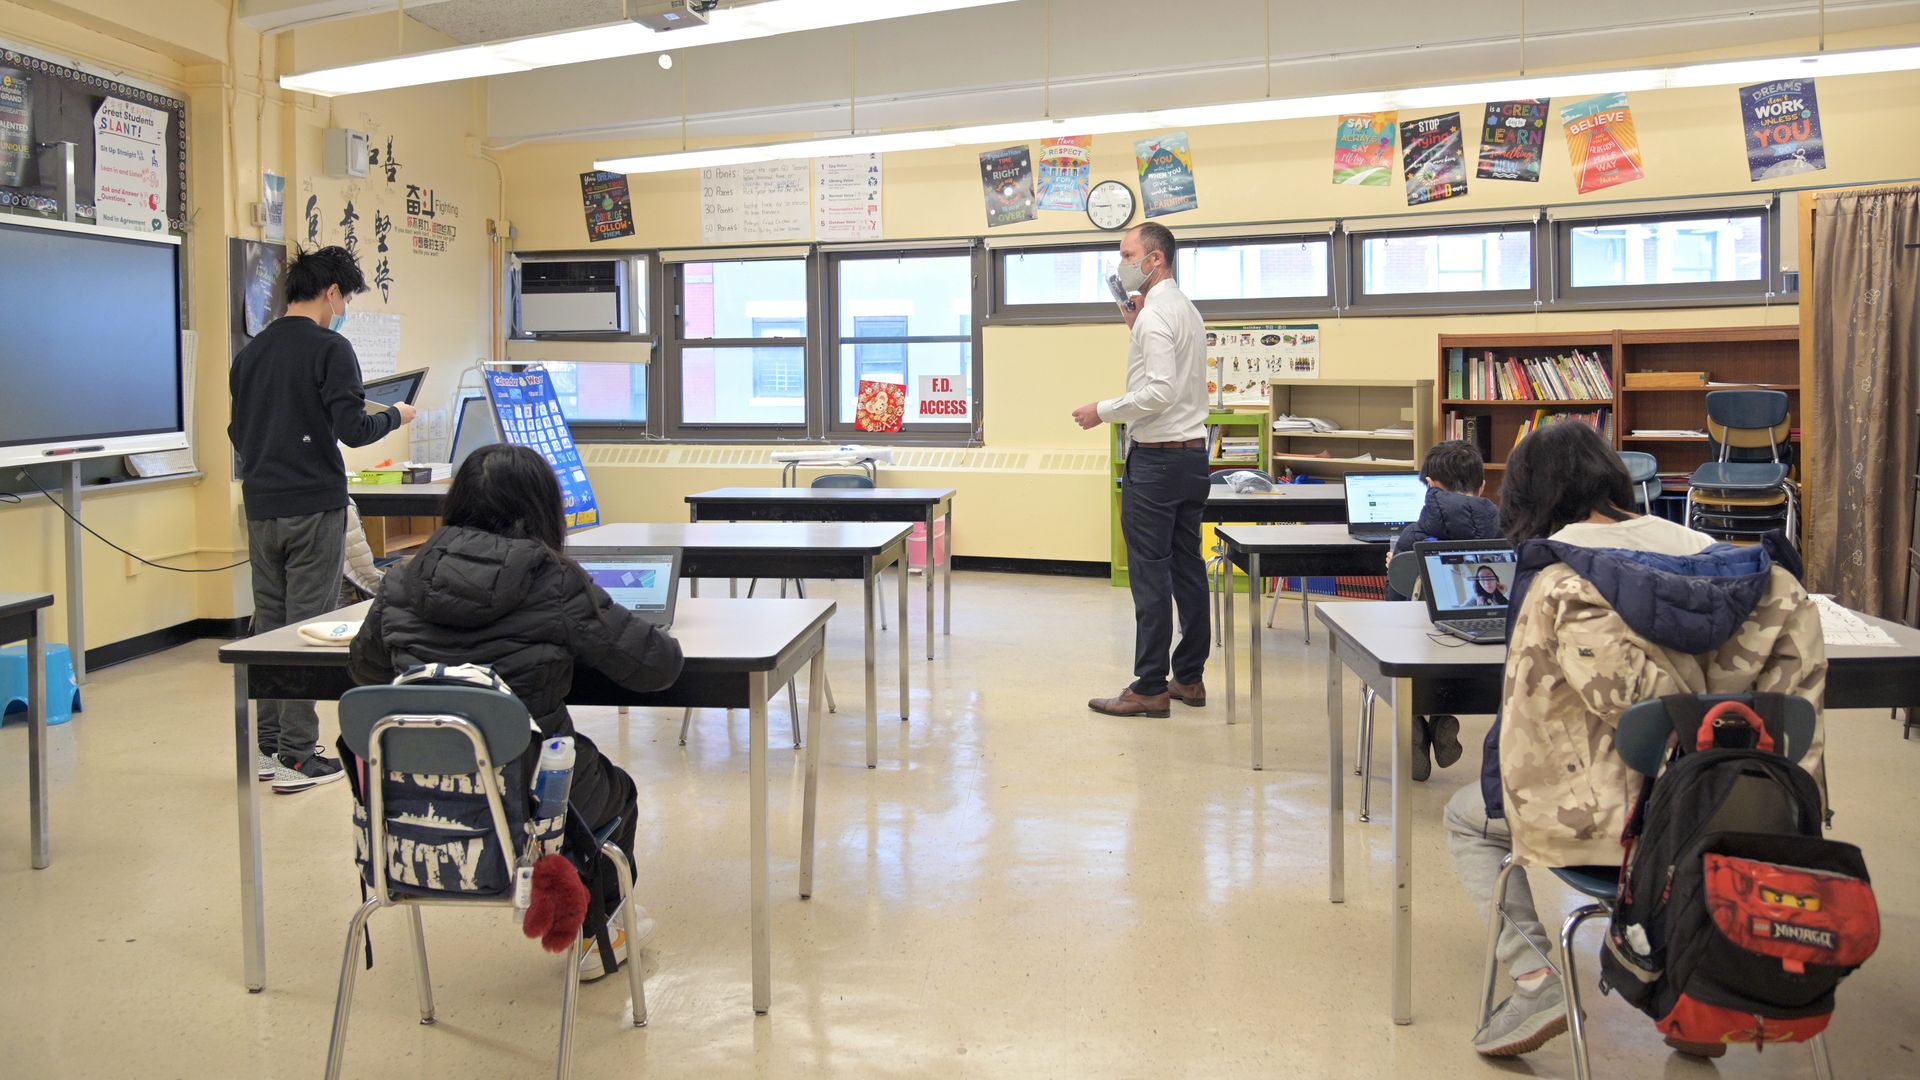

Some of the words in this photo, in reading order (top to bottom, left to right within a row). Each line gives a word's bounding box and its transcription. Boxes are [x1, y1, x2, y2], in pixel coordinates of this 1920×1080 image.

[0, 92, 22, 103] GRAND
[1752, 82, 1802, 101] DREAMS
[1503, 104, 1547, 117] GREAT
[1755, 99, 1805, 119] WORK
[101, 105, 123, 118] Great
[124, 111, 154, 127] Students
[1761, 114, 1798, 126] UNLESS
[101, 117, 142, 138] SLANT!
[1347, 118, 1372, 129] SAY
[1418, 119, 1440, 133] STOP
[1570, 112, 1624, 135] BELIEVE
[1485, 128, 1543, 145] LEARN
[1753, 119, 1811, 148] YOU
[1411, 132, 1450, 149] trying
[108, 146, 116, 155] Up
[1048, 148, 1082, 156] RESPECT
[1352, 144, 1369, 153] SAY
[1154, 155, 1173, 164] YOU
[1595, 160, 1617, 172] WAY
[703, 169, 712, 179] 10
[716, 167, 737, 179] Points
[992, 168, 1020, 180] RIGHT
[1168, 167, 1182, 177] YOU
[101, 193, 126, 203] Questions
[122, 189, 139, 197] Answer
[704, 187, 713, 197] 20
[406, 184, 435, 219] 奋斗
[435, 199, 459, 218] Fighting
[705, 204, 715, 214] 30
[594, 221, 627, 234] FOLLOW
[494, 375, 519, 387] Calendar
[932, 377, 953, 393] F.D.
[919, 400, 967, 415] ACCESS
[384, 832, 484, 890] CITY
[1772, 922, 1834, 949] NINJAGO
